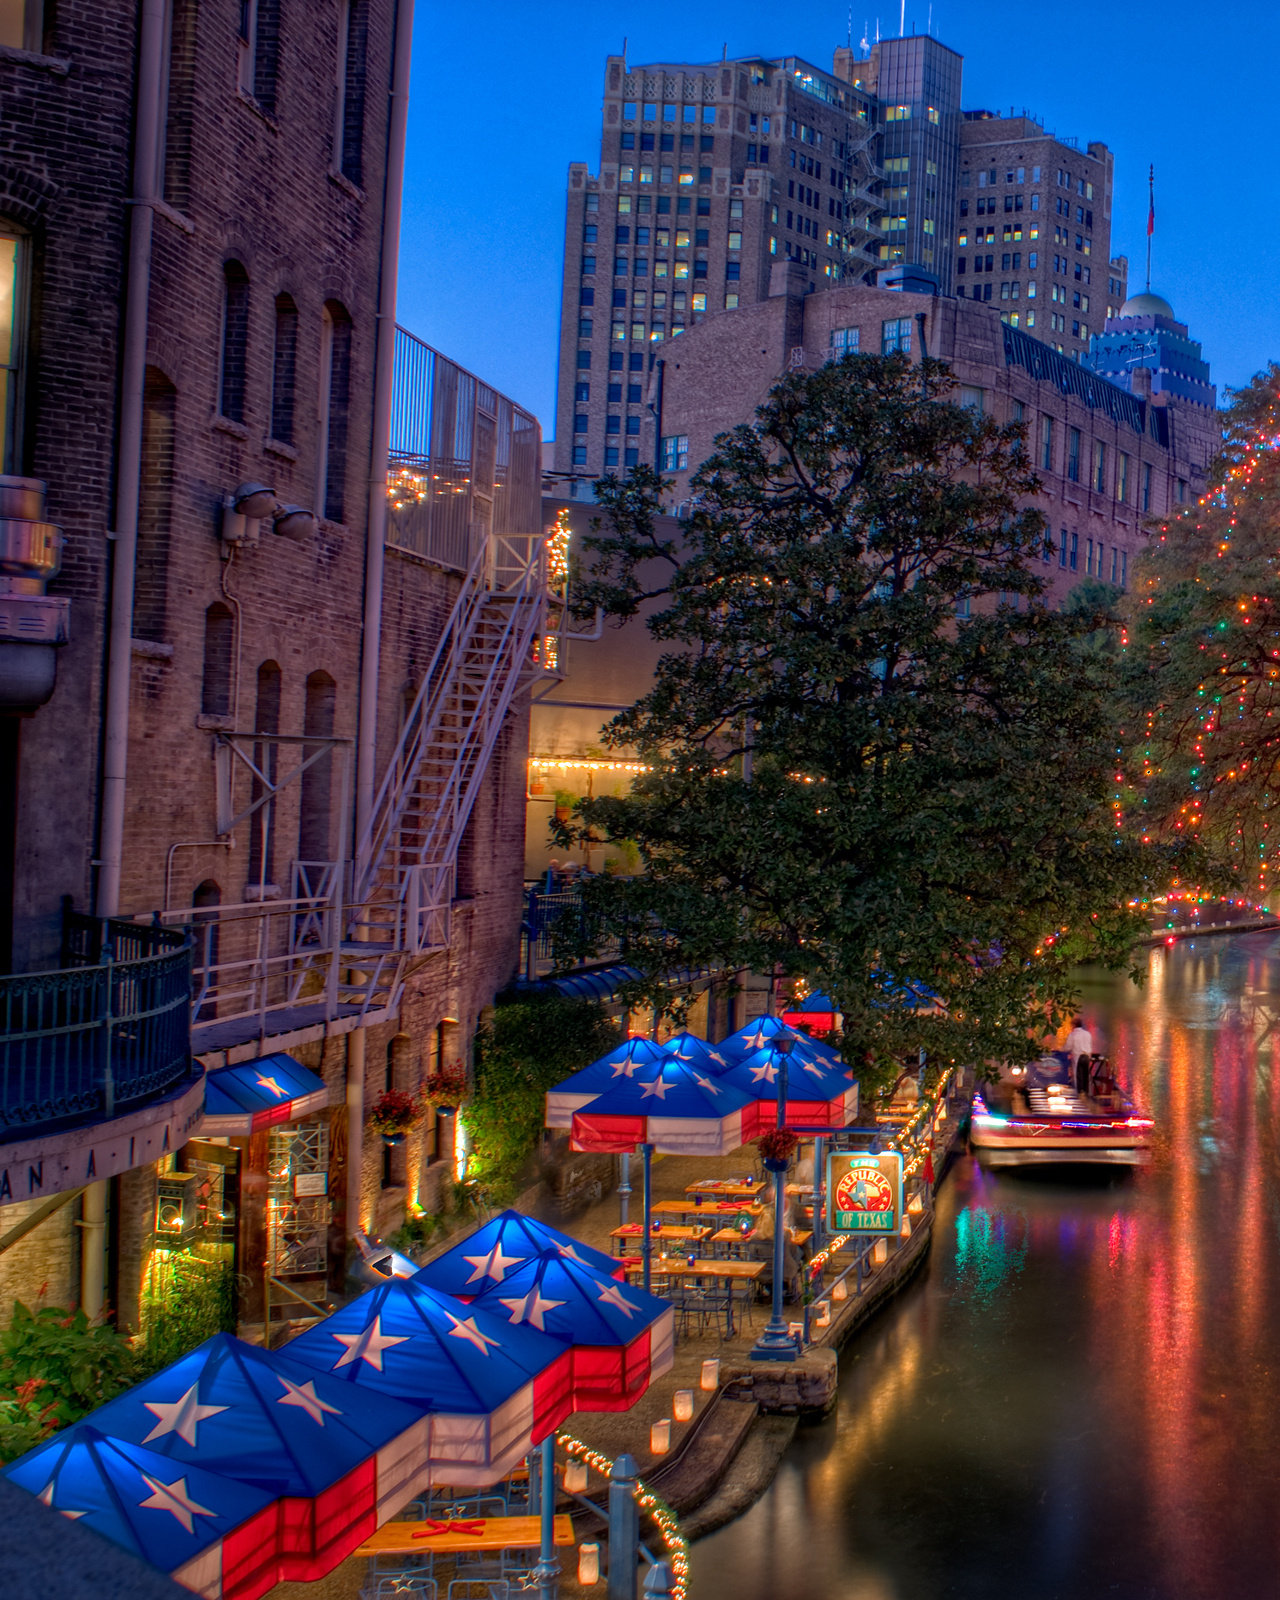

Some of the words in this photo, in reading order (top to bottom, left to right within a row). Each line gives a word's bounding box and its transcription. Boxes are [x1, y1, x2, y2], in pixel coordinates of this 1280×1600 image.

[853, 1160, 876, 1168] THE
[838, 1171, 891, 1194] REPUBLIC
[842, 1213, 854, 1229] OF
[857, 1213, 888, 1229] TEXAS
